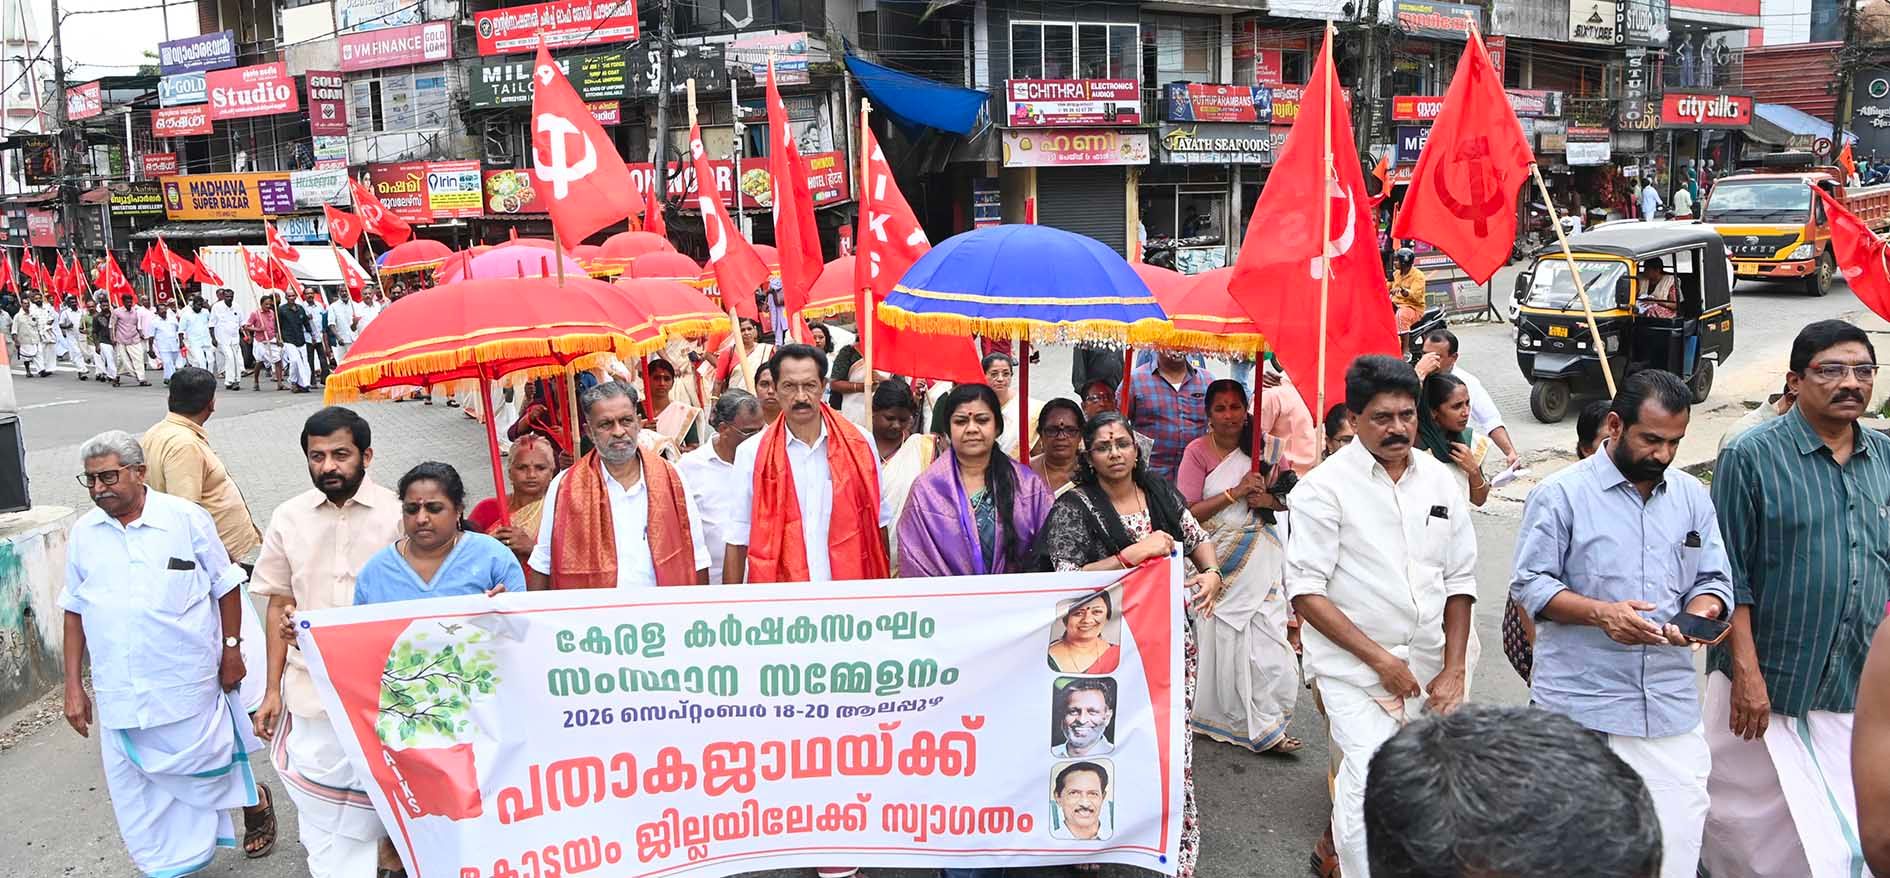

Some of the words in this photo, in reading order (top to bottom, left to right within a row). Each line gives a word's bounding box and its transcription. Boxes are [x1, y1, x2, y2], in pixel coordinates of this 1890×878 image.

[1616, 2, 1625, 43] UDIO
[354, 43, 371, 57] VM
[371, 36, 421, 56] FINANCE
[425, 30, 445, 43] GOLD
[425, 41, 446, 53] LOAN
[311, 76, 342, 88] GOLD
[481, 59, 570, 83] MILN
[212, 80, 290, 109] Studio
[312, 88, 343, 100] LOAN
[1028, 83, 1086, 99] CHITHRA
[1090, 82, 1134, 92] ELECTRONICS
[1091, 91, 1115, 100] AUDIOS
[1678, 96, 1705, 122] city
[1707, 95, 1738, 118] silks
[1214, 139, 1270, 152] SEAFOODS
[189, 180, 248, 197] MADHAVA
[193, 197, 221, 210] SUPER
[221, 195, 250, 209] BAZAR
[556, 622, 666, 658] കേരള
[684, 610, 936, 649] കർഷകസംഘം
[547, 664, 738, 698] സംസ്ഥാന
[759, 657, 959, 698] സമ്മേളനം
[563, 707, 614, 729] 2026
[621, 699, 766, 724] സെപ്റ്റംബർ
[773, 703, 829, 721] 18-20
[835, 695, 945, 720] ആലപ്പുഴ
[383, 749, 421, 813] AIKS
[497, 714, 986, 826] പതാകജാഥയ്ക്ക്
[635, 792, 873, 863] ജില്ലയിലേക്ക്
[882, 802, 1035, 843] സ്വാഗതം
